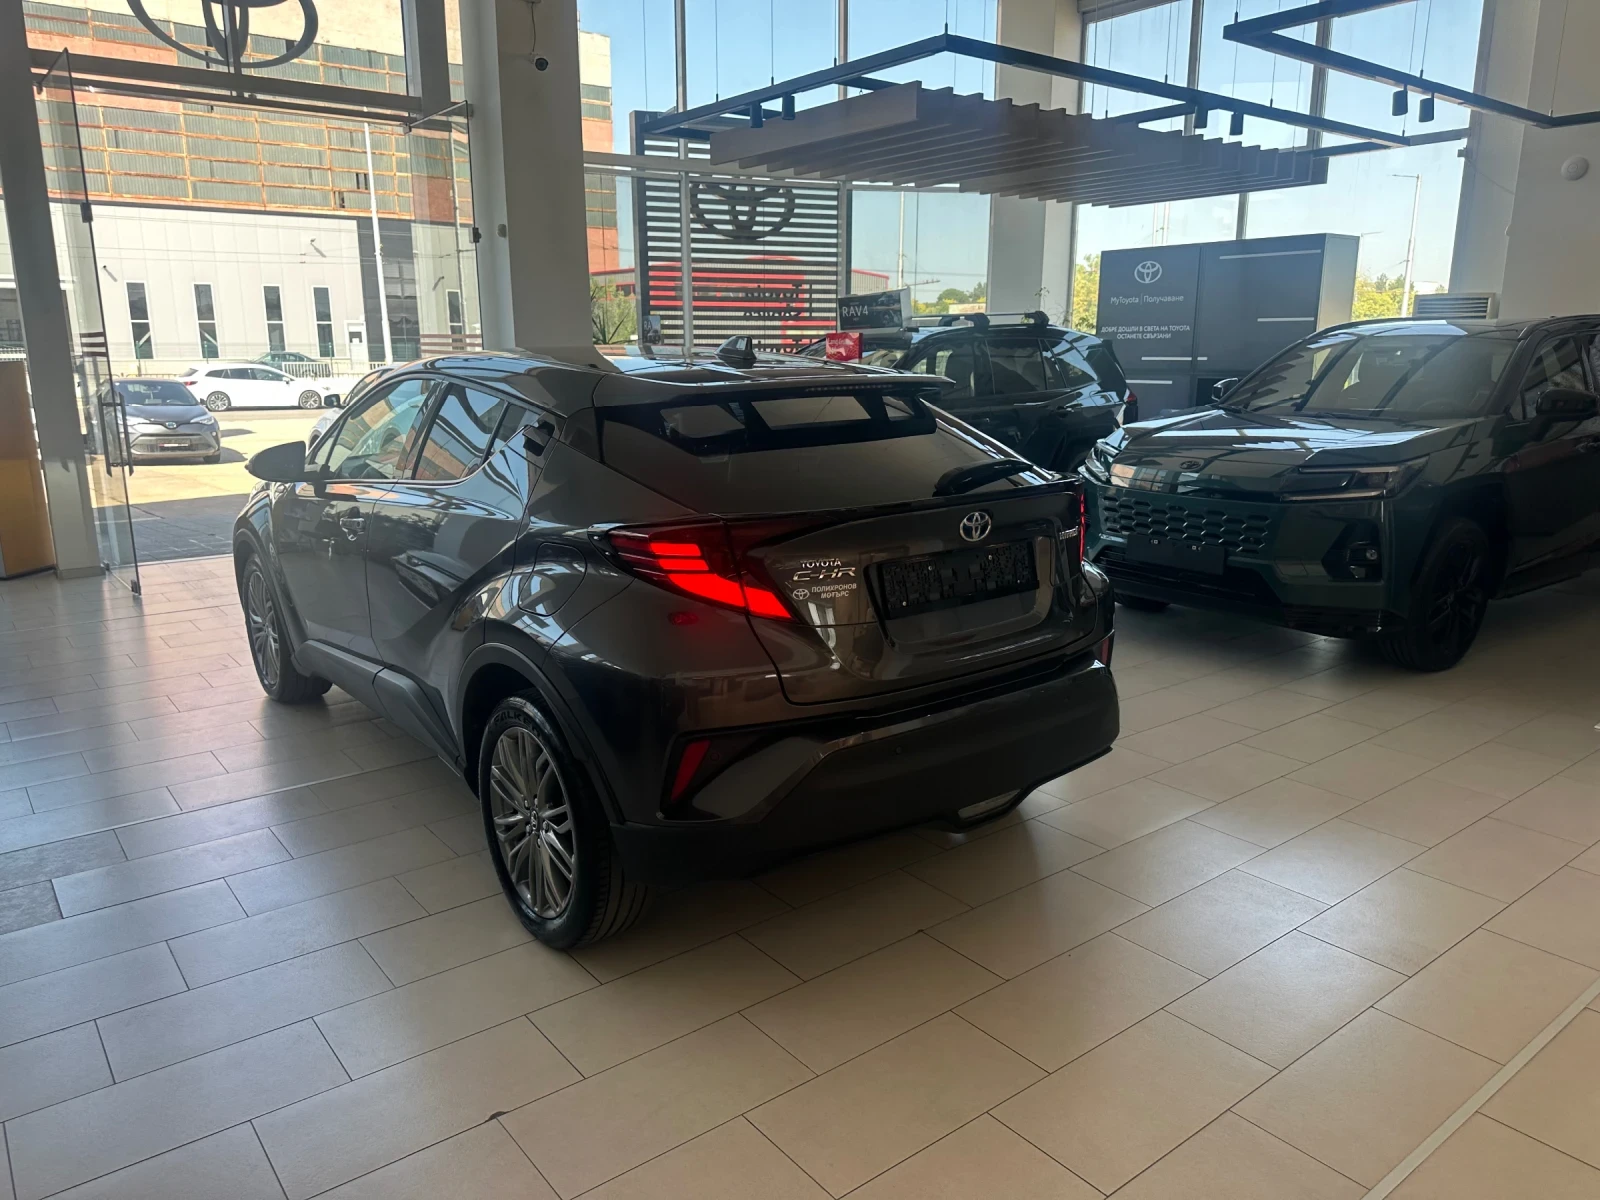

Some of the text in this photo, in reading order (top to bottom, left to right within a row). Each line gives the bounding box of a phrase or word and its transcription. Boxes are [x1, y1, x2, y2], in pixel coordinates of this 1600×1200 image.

[1110, 295, 1185, 305] MyToyota Получаване
[842, 305, 869, 317] RAV4
[800, 558, 841, 568] TOYOTA
[793, 567, 856, 580] C-HR
[811, 583, 857, 592] ПОЛИХРОНОВ
[820, 590, 849, 599] МОТЪРС
